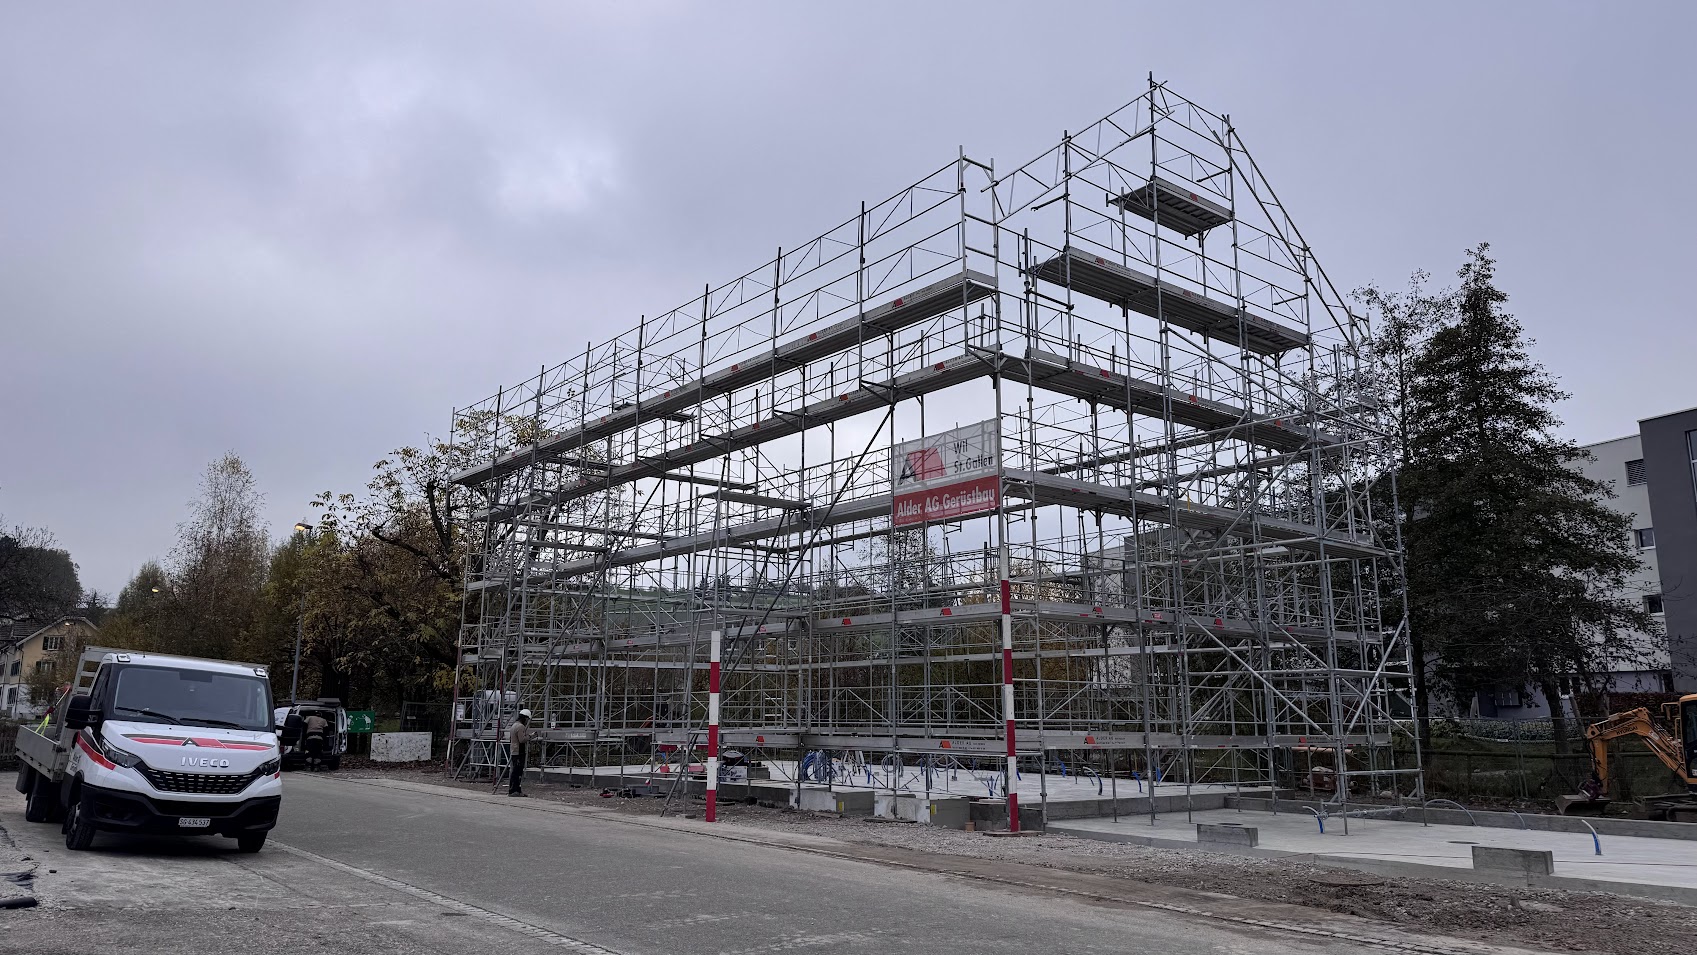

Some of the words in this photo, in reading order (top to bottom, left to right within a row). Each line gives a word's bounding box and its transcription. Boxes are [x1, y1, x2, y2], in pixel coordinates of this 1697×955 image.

[953, 439, 968, 455] Wil
[896, 501, 922, 518] Alder
[924, 495, 940, 513] AG
[942, 486, 995, 510] Gerüstbau
[181, 756, 230, 768] IVECO
